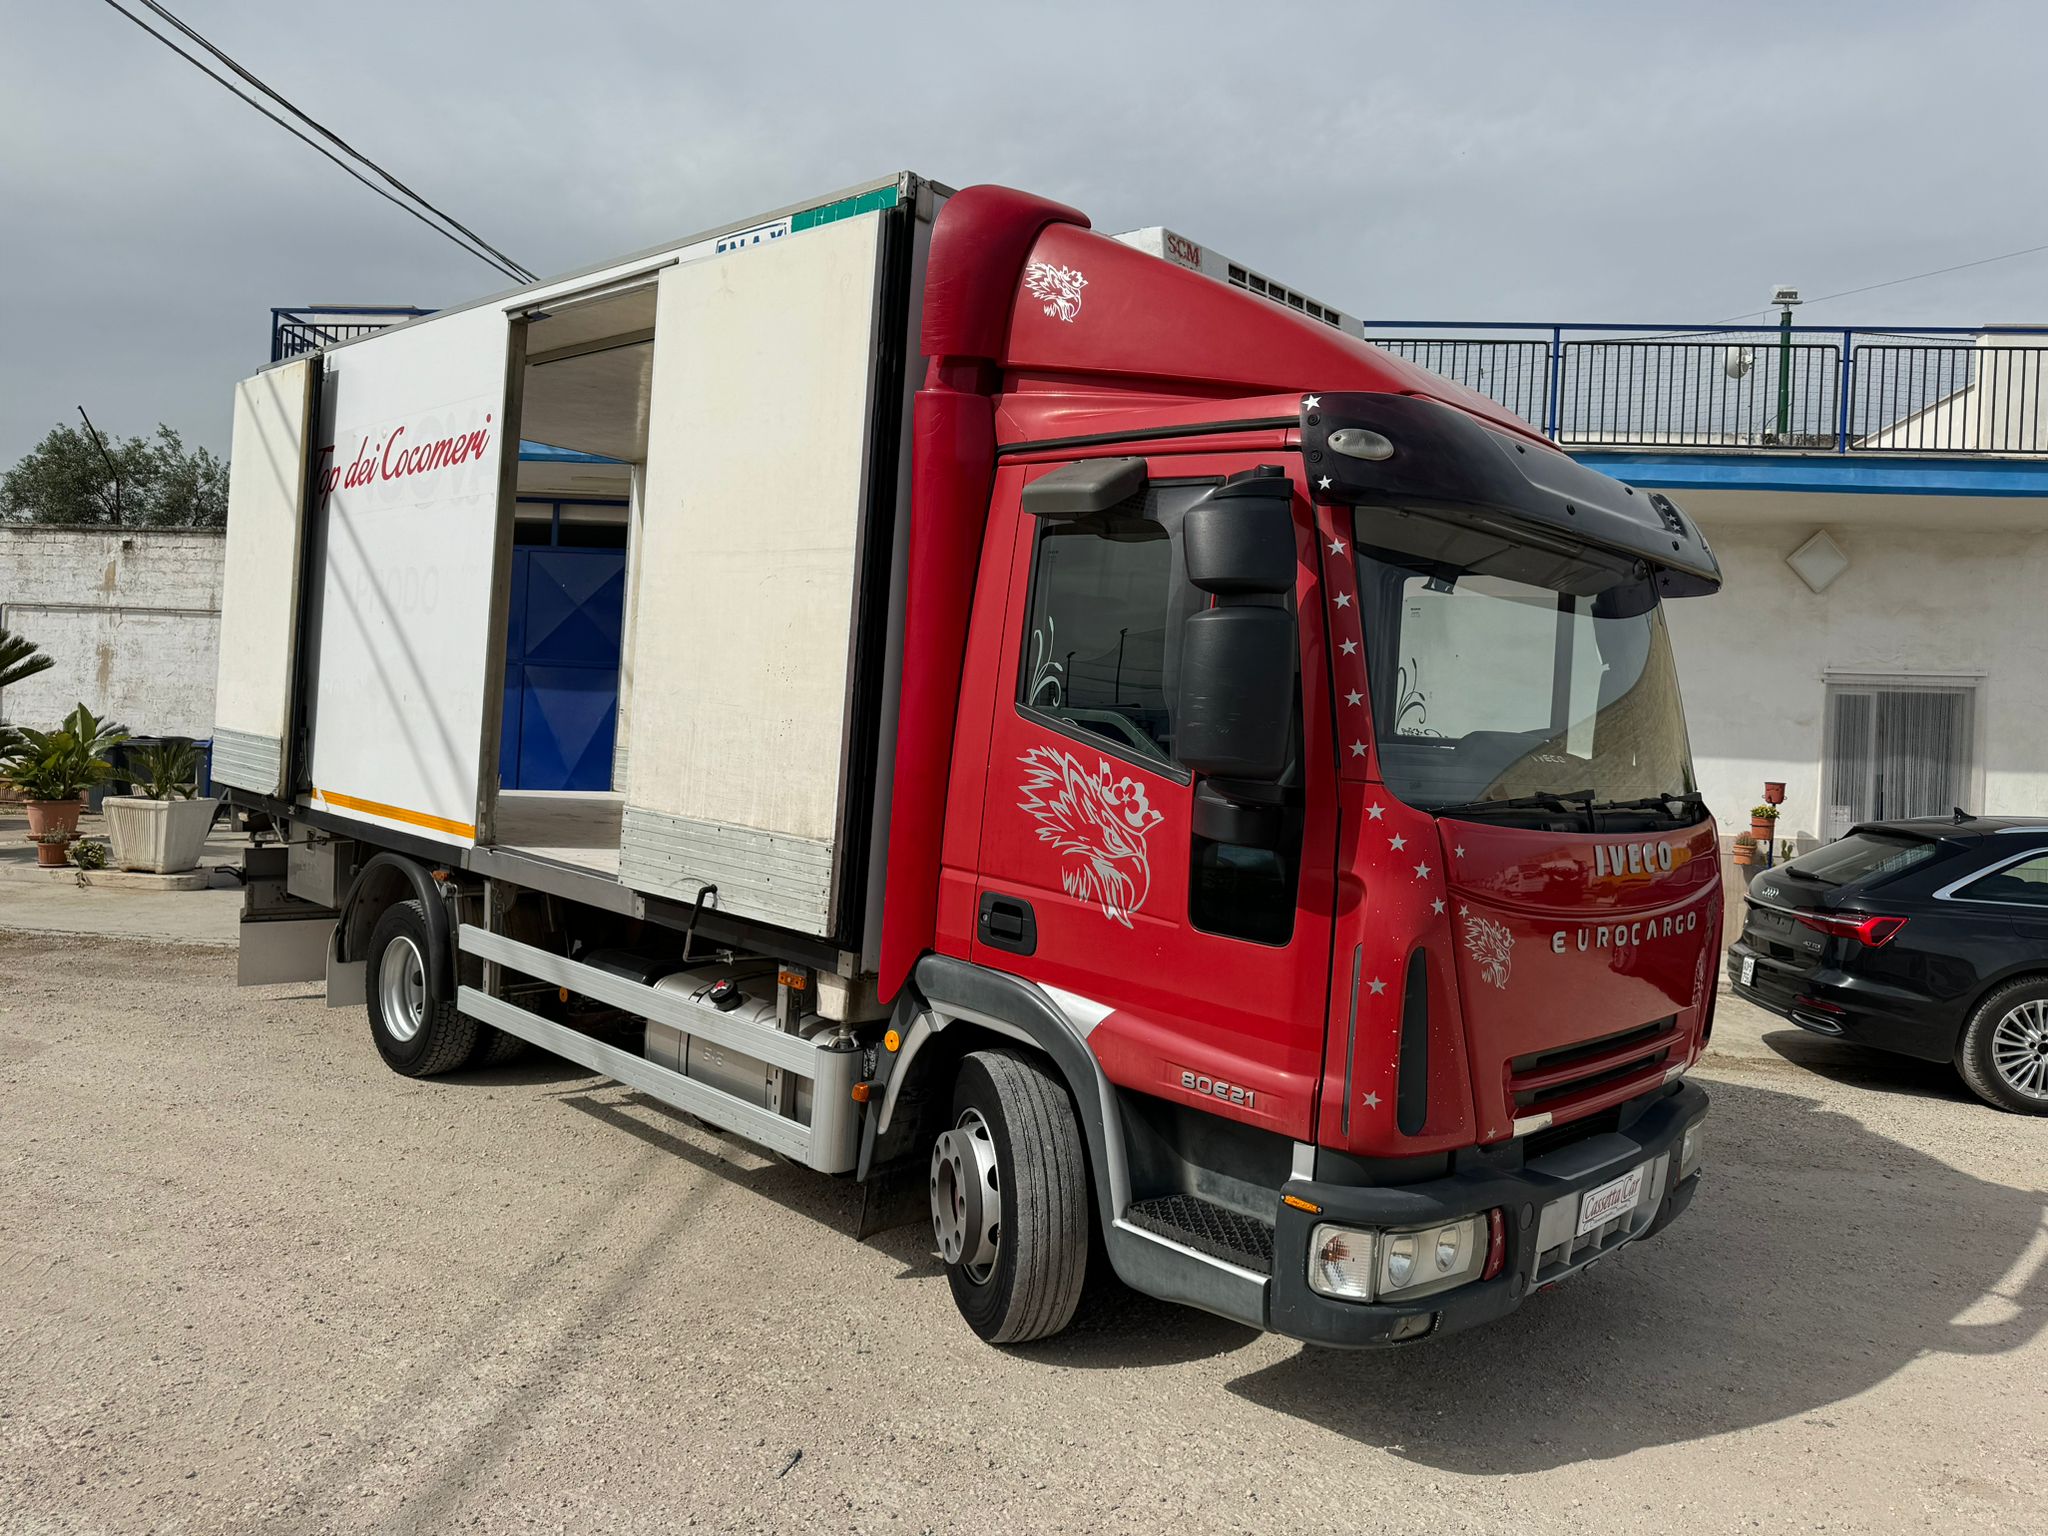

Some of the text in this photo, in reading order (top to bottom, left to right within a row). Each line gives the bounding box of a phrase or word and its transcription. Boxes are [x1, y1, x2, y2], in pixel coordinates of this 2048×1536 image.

[1167, 231, 1201, 267] SCM
[317, 413, 492, 511] Top dei Cocomeri
[1593, 841, 1673, 876] IVECO
[1552, 911, 1697, 954] EUROCARGO
[1181, 1071, 1255, 1109] 80E21
[1584, 1186, 1622, 1220] Cassetta
[1623, 1176, 1641, 1200] Car
